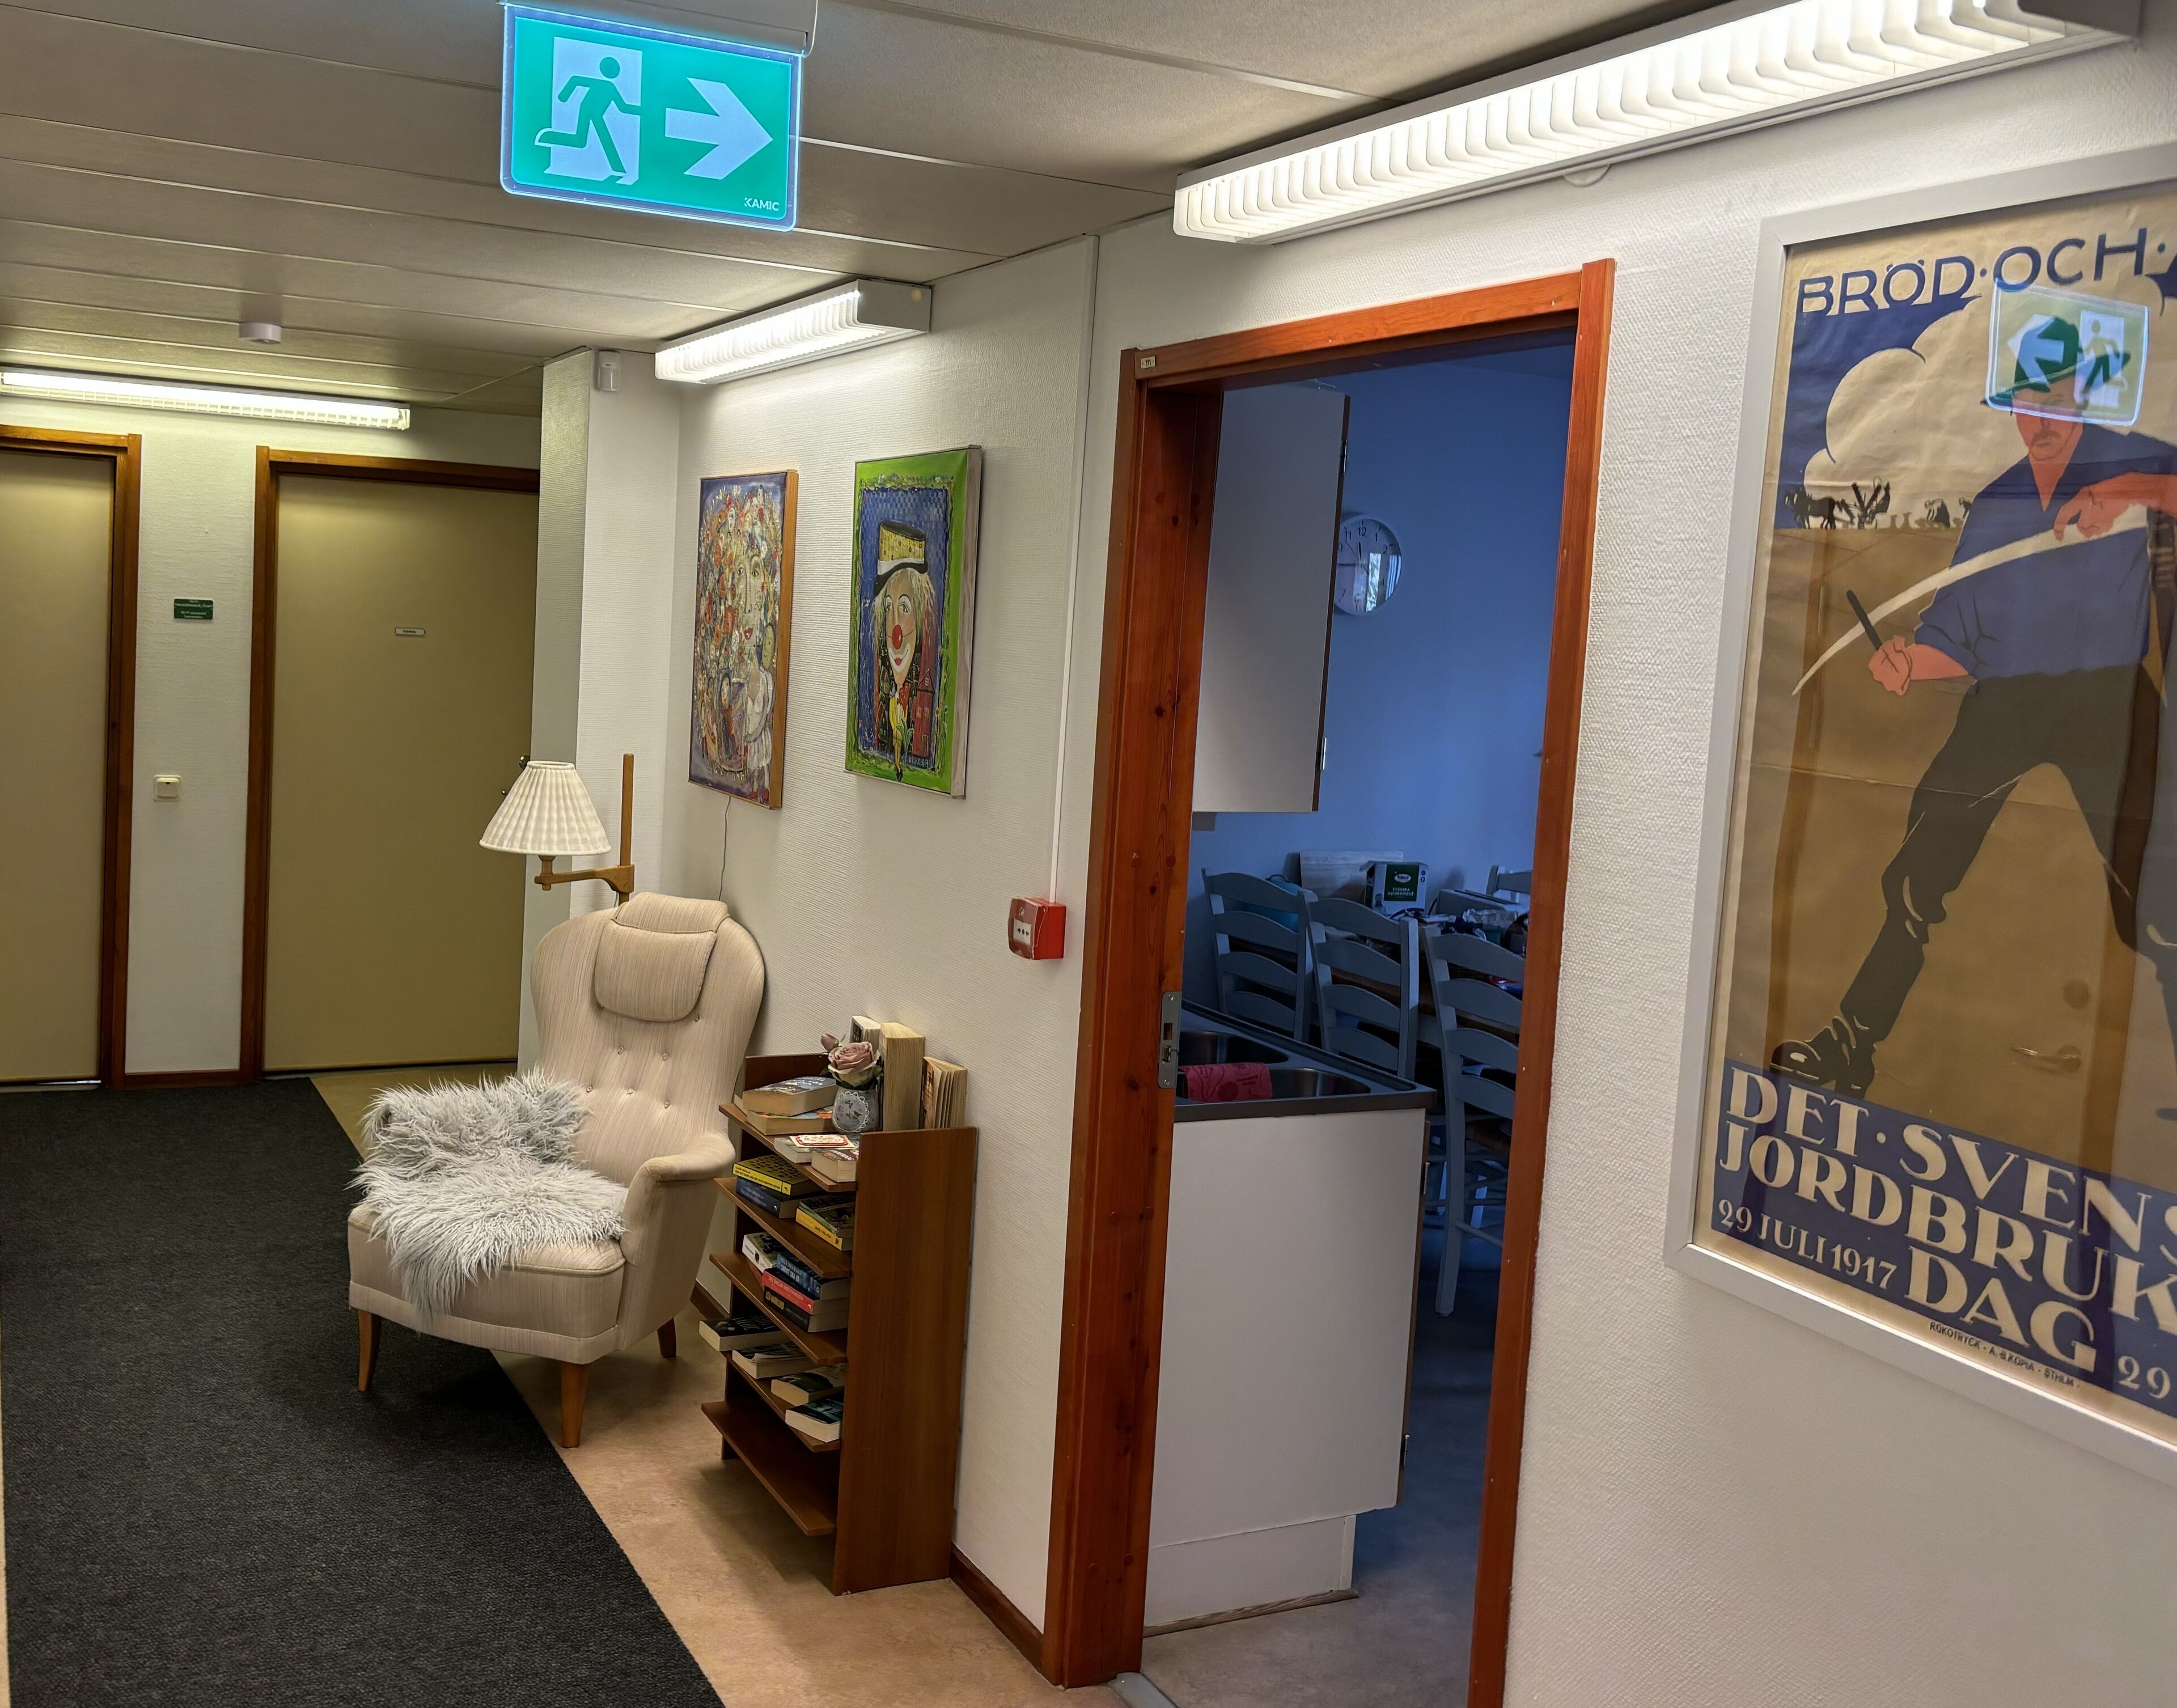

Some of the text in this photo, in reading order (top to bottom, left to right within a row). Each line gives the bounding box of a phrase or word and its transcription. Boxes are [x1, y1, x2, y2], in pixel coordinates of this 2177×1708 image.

[744, 197, 780, 211] KAMIC
[1798, 228, 2148, 315] BRÖD OCH
[1727, 1067, 1869, 1156] DET
[1718, 1199, 1898, 1290] 29 JULI 1917
[1904, 1246, 2097, 1374] DAG
[2117, 1355, 2171, 1400] 29
